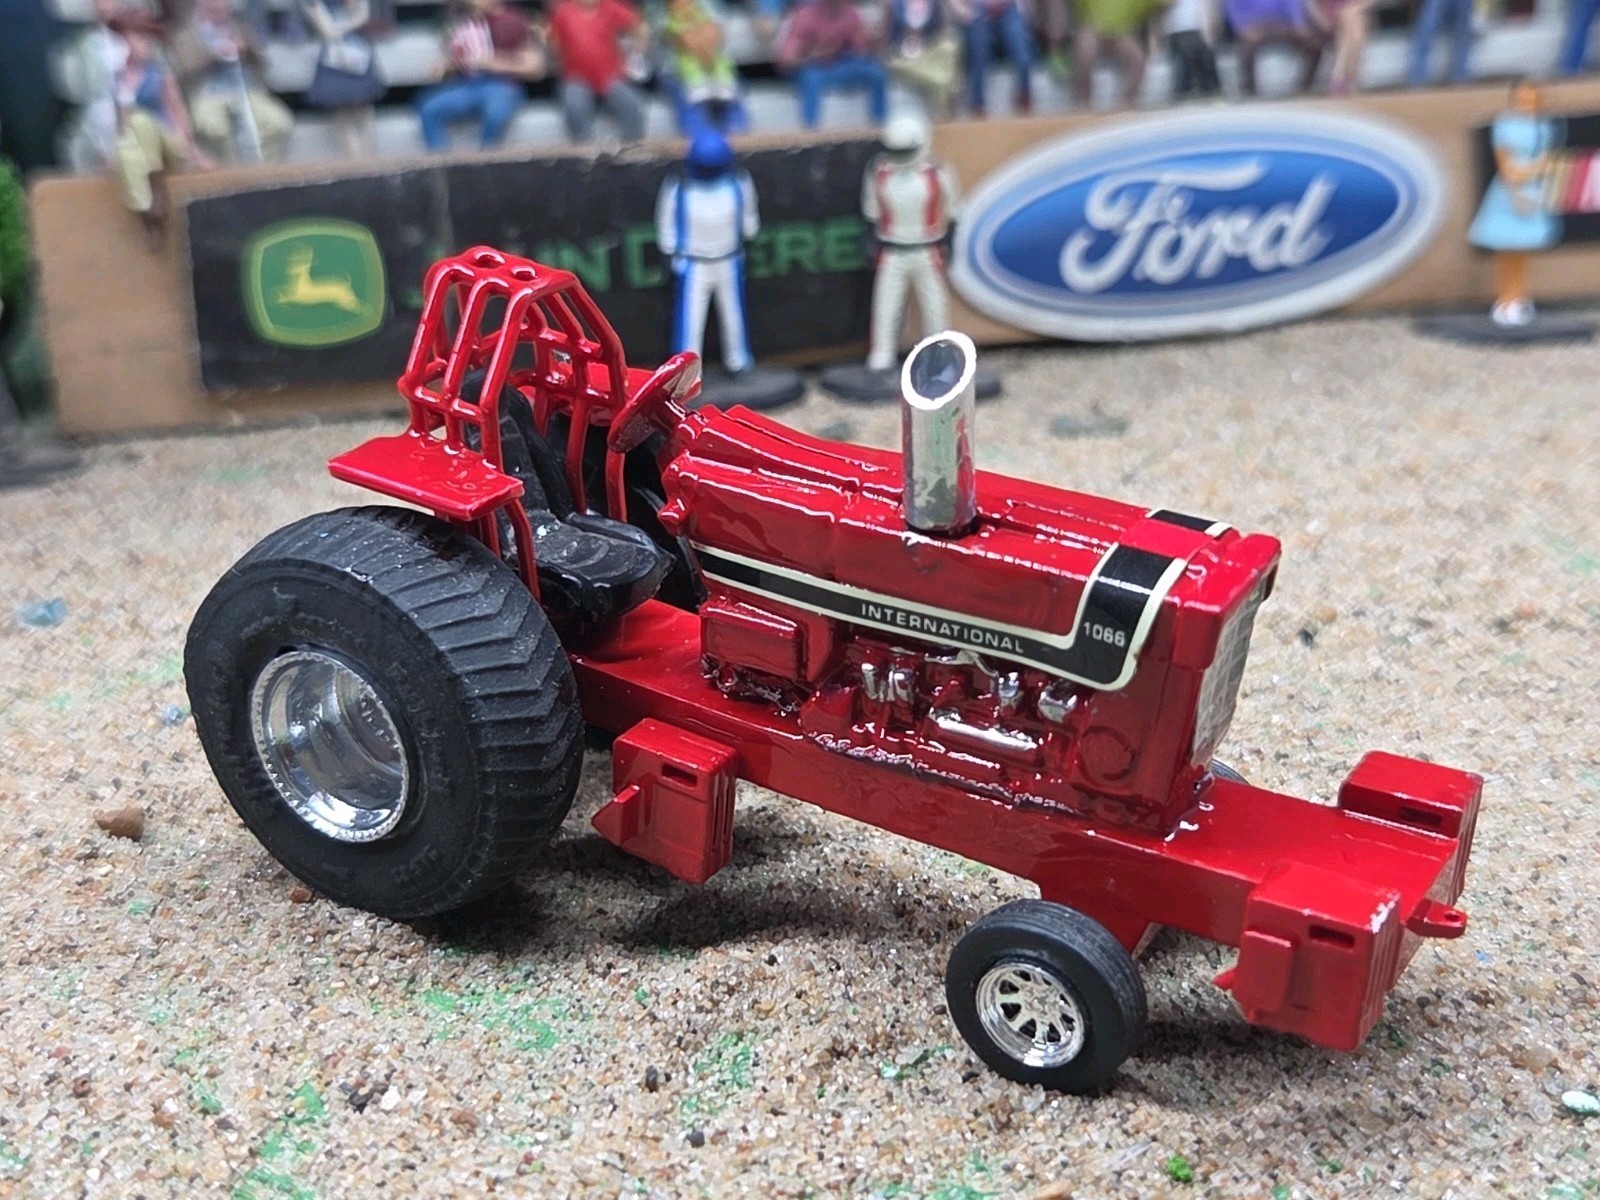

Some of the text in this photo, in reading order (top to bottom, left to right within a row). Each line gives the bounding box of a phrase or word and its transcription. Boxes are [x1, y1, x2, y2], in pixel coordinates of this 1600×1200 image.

[1058, 154, 1337, 293] Ford
[860, 602, 1024, 654] INTERNATIONAL
[1083, 621, 1126, 648] 1066
